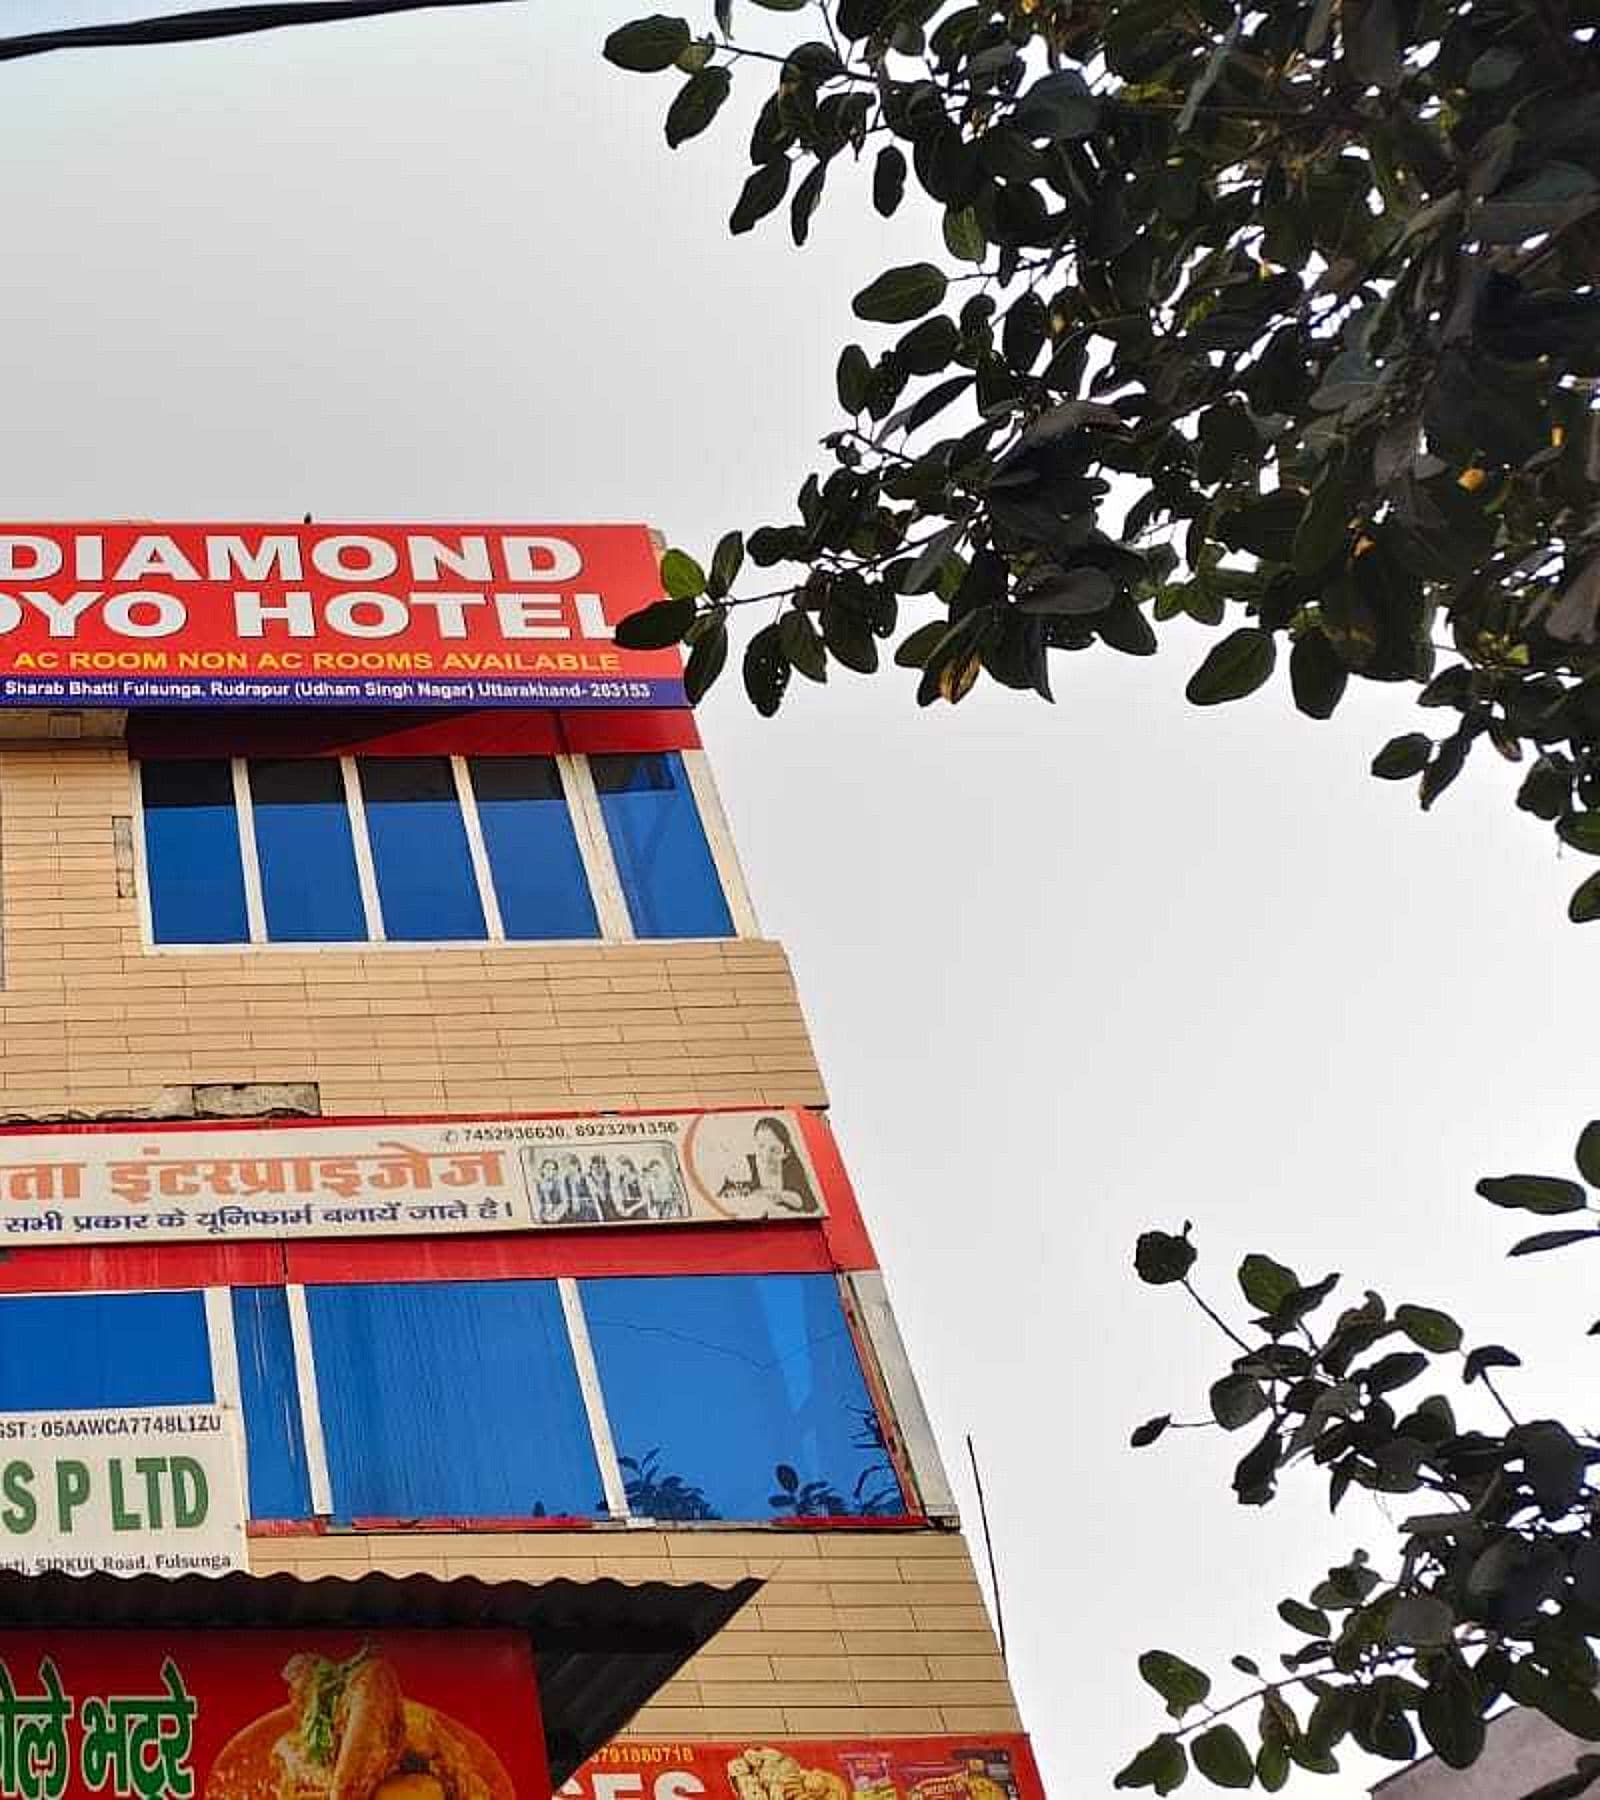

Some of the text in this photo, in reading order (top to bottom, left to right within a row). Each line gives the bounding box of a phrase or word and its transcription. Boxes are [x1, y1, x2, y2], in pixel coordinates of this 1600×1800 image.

[233, 591, 619, 640] HOTEL
[14, 651, 624, 672] AC ROOM NON AC ROOMS AVAILABLE
[5, 681, 65, 696] Sharab
[69, 681, 119, 696] Bhatti
[211, 682, 290, 700] Rudrapur
[293, 682, 360, 699] (Udham
[364, 682, 413, 700] Singh
[417, 682, 474, 700] Nagar)
[477, 683, 586, 699] Uttarakhand-
[106, 1141, 505, 1205] इंटरप्राइजेज
[5, 1208, 64, 1233] सभी
[72, 1212, 149, 1233] प्रकार
[155, 1207, 187, 1228] के
[408, 1198, 471, 1221] जाते
[54, 1459, 93, 1533] P
[106, 1455, 211, 1530] LTD
[155, 1553, 232, 1569] Fulsunga
